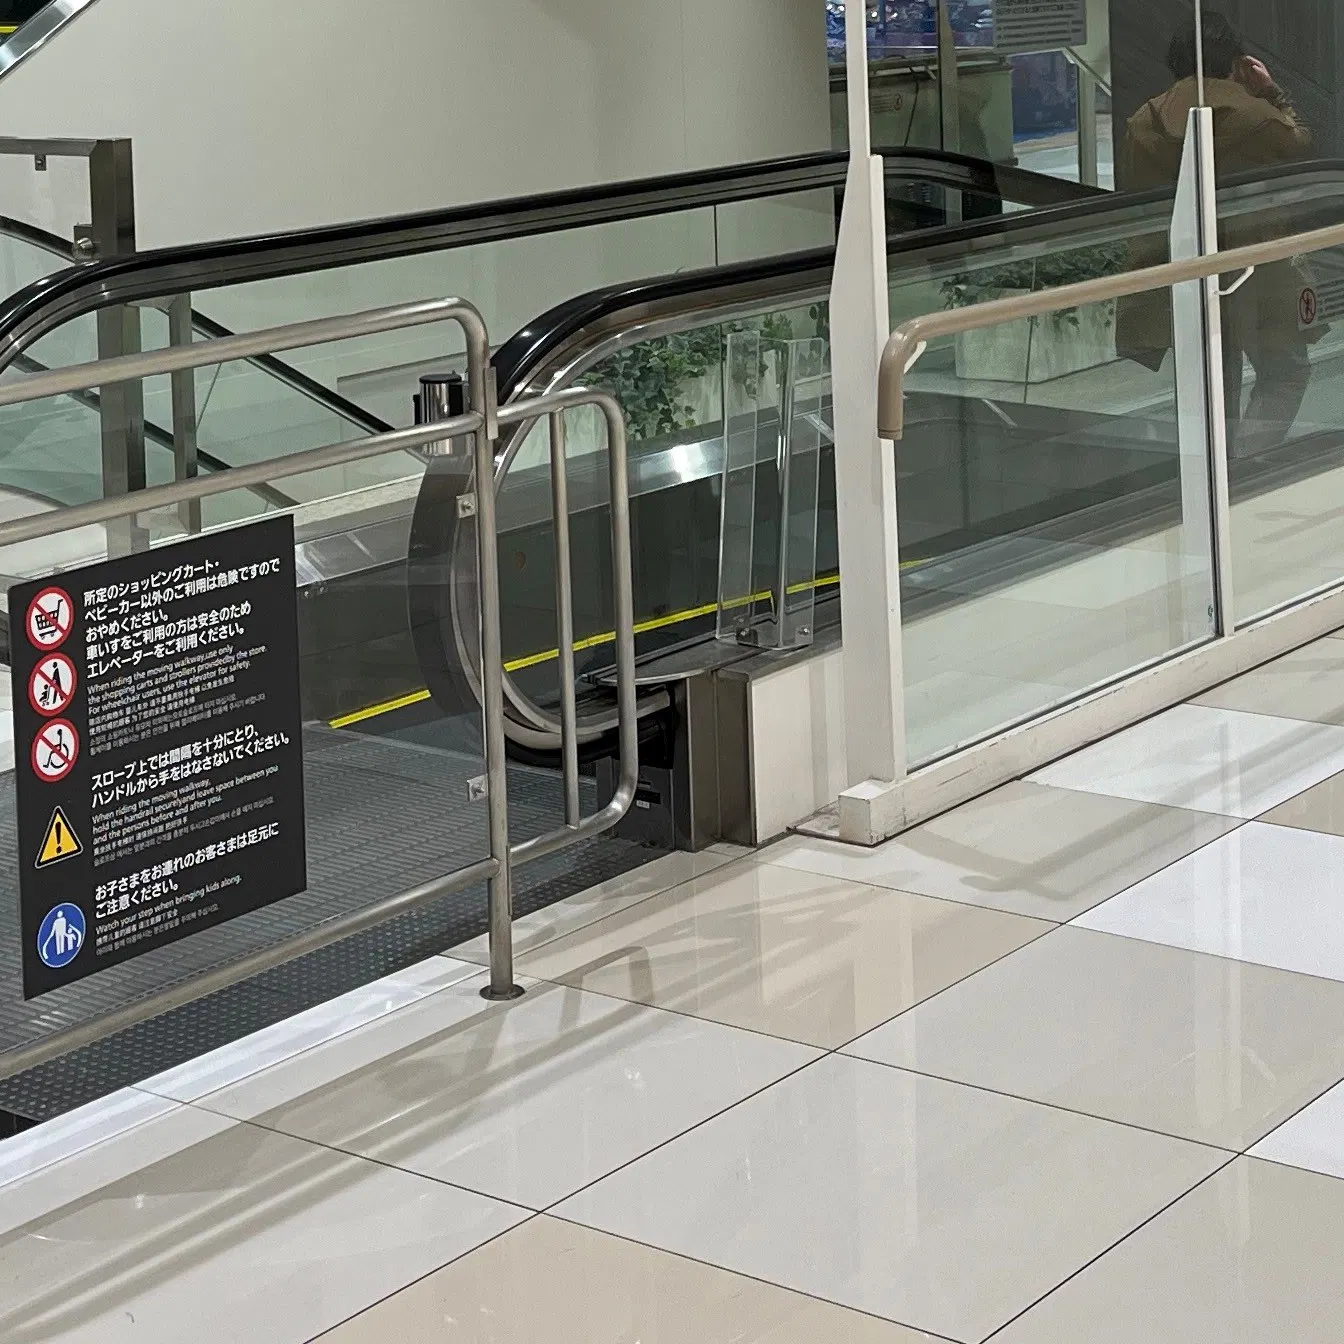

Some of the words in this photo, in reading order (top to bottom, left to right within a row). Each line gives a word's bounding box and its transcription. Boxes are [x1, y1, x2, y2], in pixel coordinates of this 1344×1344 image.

[85, 558, 280, 621] ベビーカー以外のご利用は危険ですので
[85, 609, 168, 643] おやめください。
[86, 601, 251, 660] 車いすをご利用の方は安全のため
[87, 623, 244, 678] エレベーターをご利用ください。
[87, 695, 101, 705] the
[88, 705, 101, 715] For
[162, 683, 175, 693] use
[133, 671, 146, 681] the
[92, 725, 258, 790] スロープ上では間隔を十分にとり、
[92, 733, 289, 807] ハンドルから手をはなさないでください。
[95, 823, 278, 900] お子さまをお連れのお客さまは足元に
[96, 879, 178, 918] ご注意ください。
